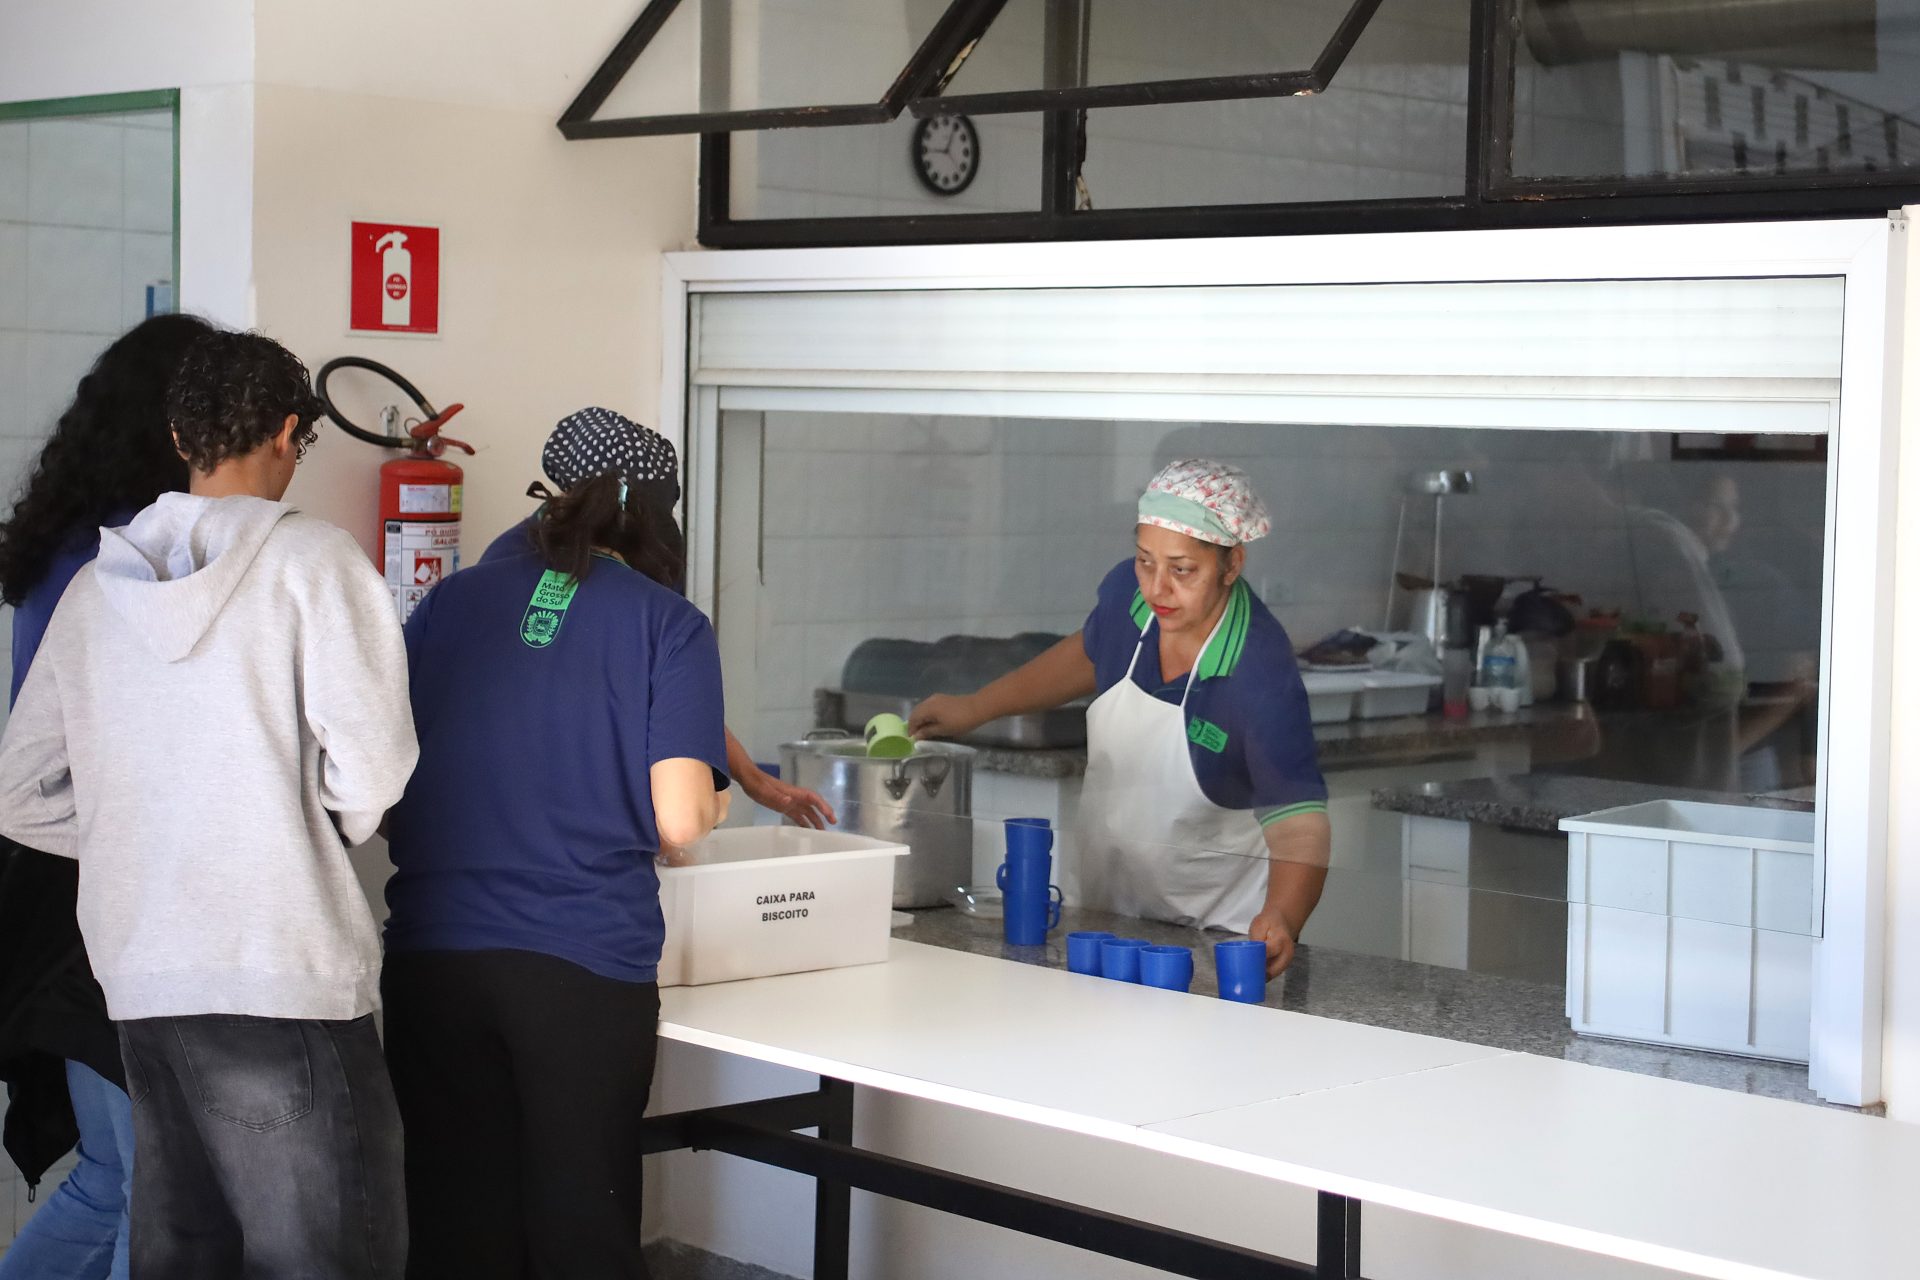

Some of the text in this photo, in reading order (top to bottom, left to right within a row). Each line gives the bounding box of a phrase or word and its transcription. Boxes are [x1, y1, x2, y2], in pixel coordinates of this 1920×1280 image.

[541, 582, 565, 592] Mato
[539, 588, 570, 599] Grosso
[536, 596, 564, 606] do Sul
[756, 891, 815, 905] CAIXA PARA
[762, 908, 809, 922] BISCOITO
